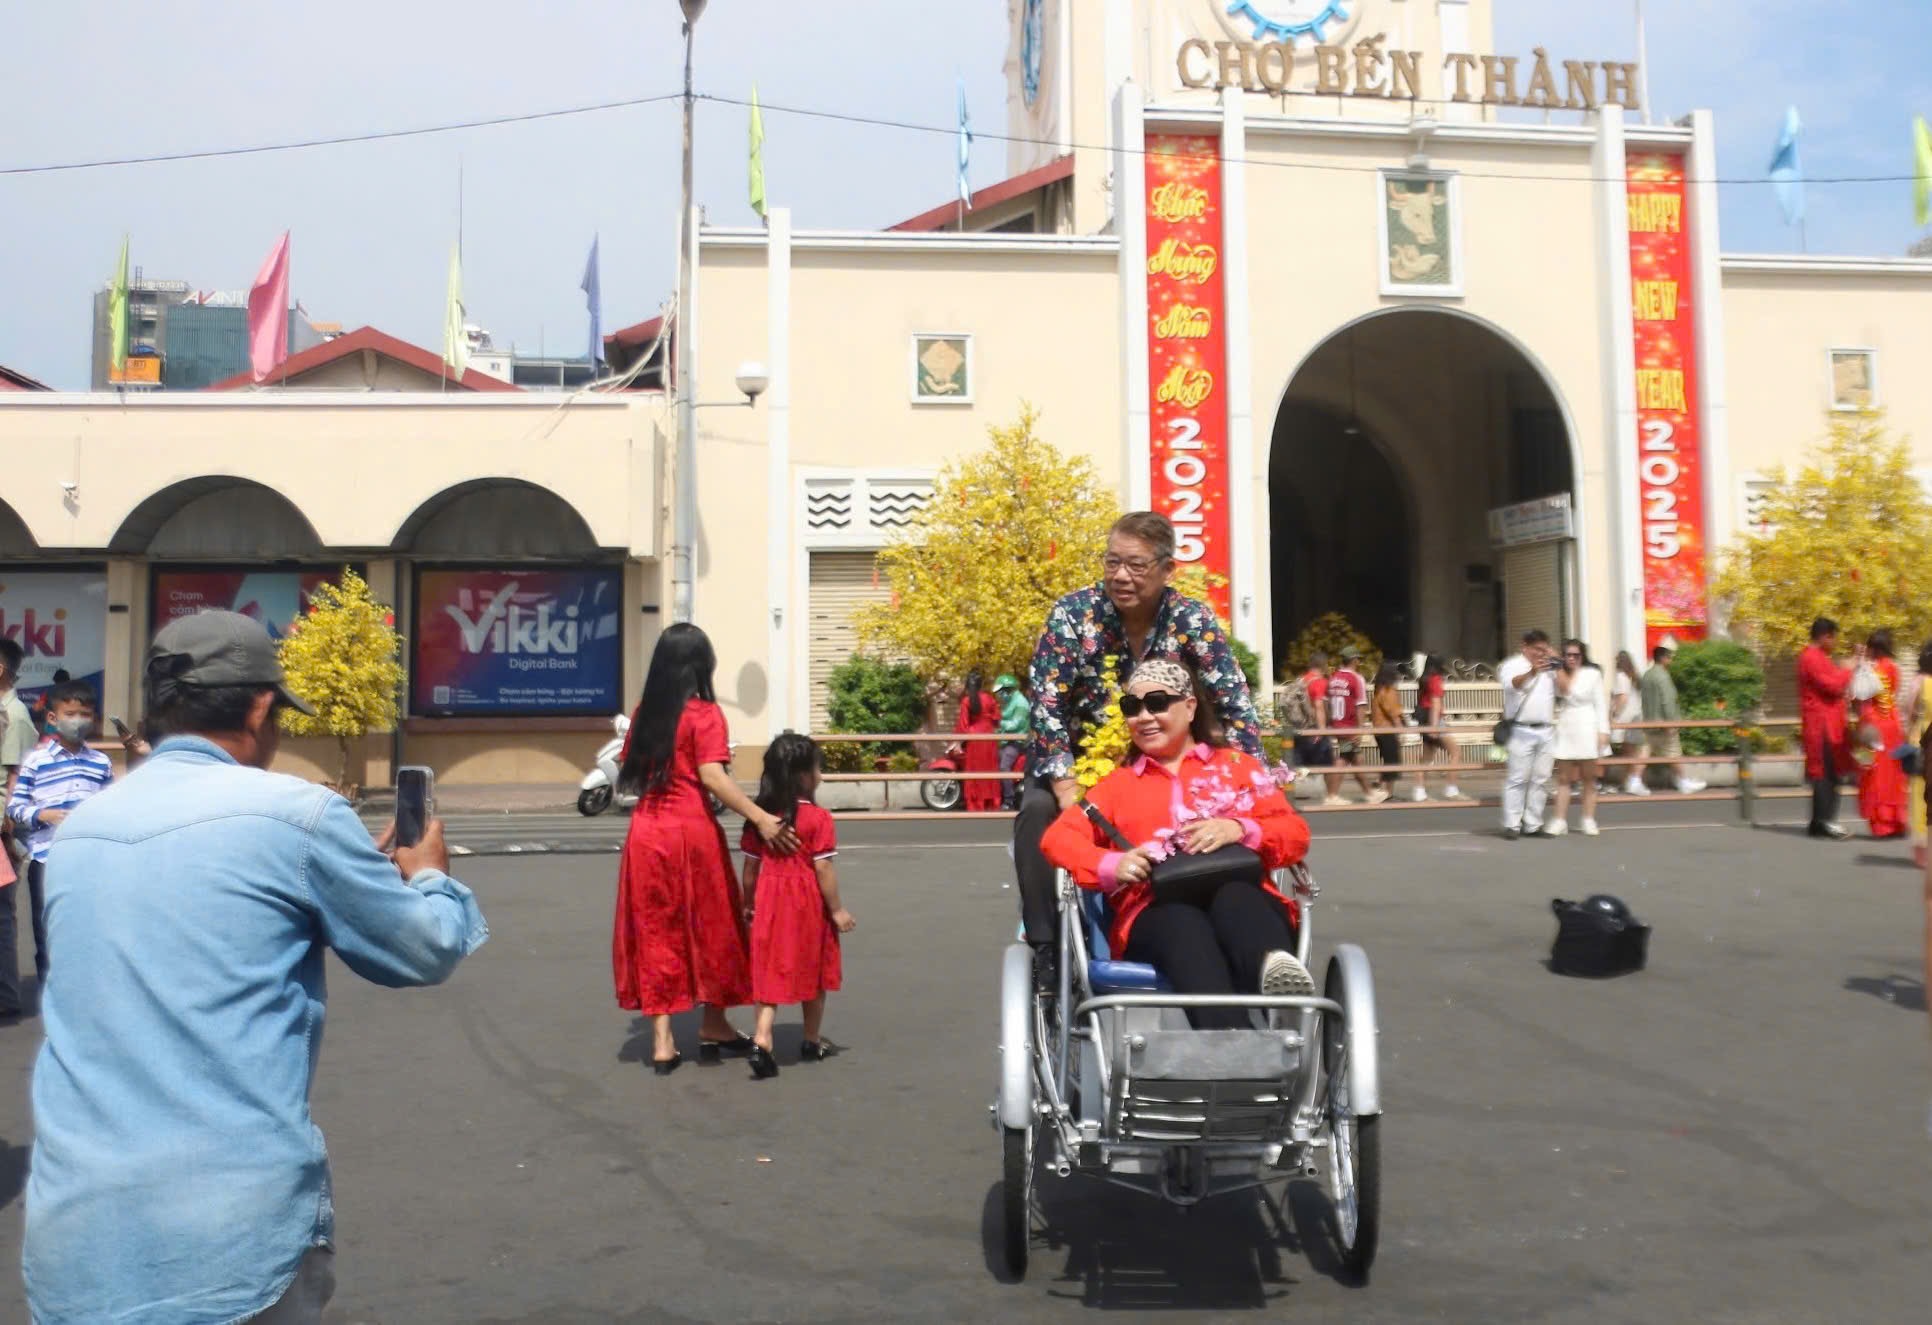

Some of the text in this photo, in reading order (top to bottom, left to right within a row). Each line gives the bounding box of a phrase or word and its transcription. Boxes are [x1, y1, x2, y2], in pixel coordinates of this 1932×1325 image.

[1177, 32, 1640, 110] CHỢ BẾN THÀNH
[1635, 280, 1679, 320] NEW
[1636, 368, 1687, 414] YEAR
[1164, 418, 1207, 562] 2025
[1641, 420, 1681, 559] 2025
[444, 581, 578, 654] Vikki
[509, 658, 577, 671] Digital Bank
